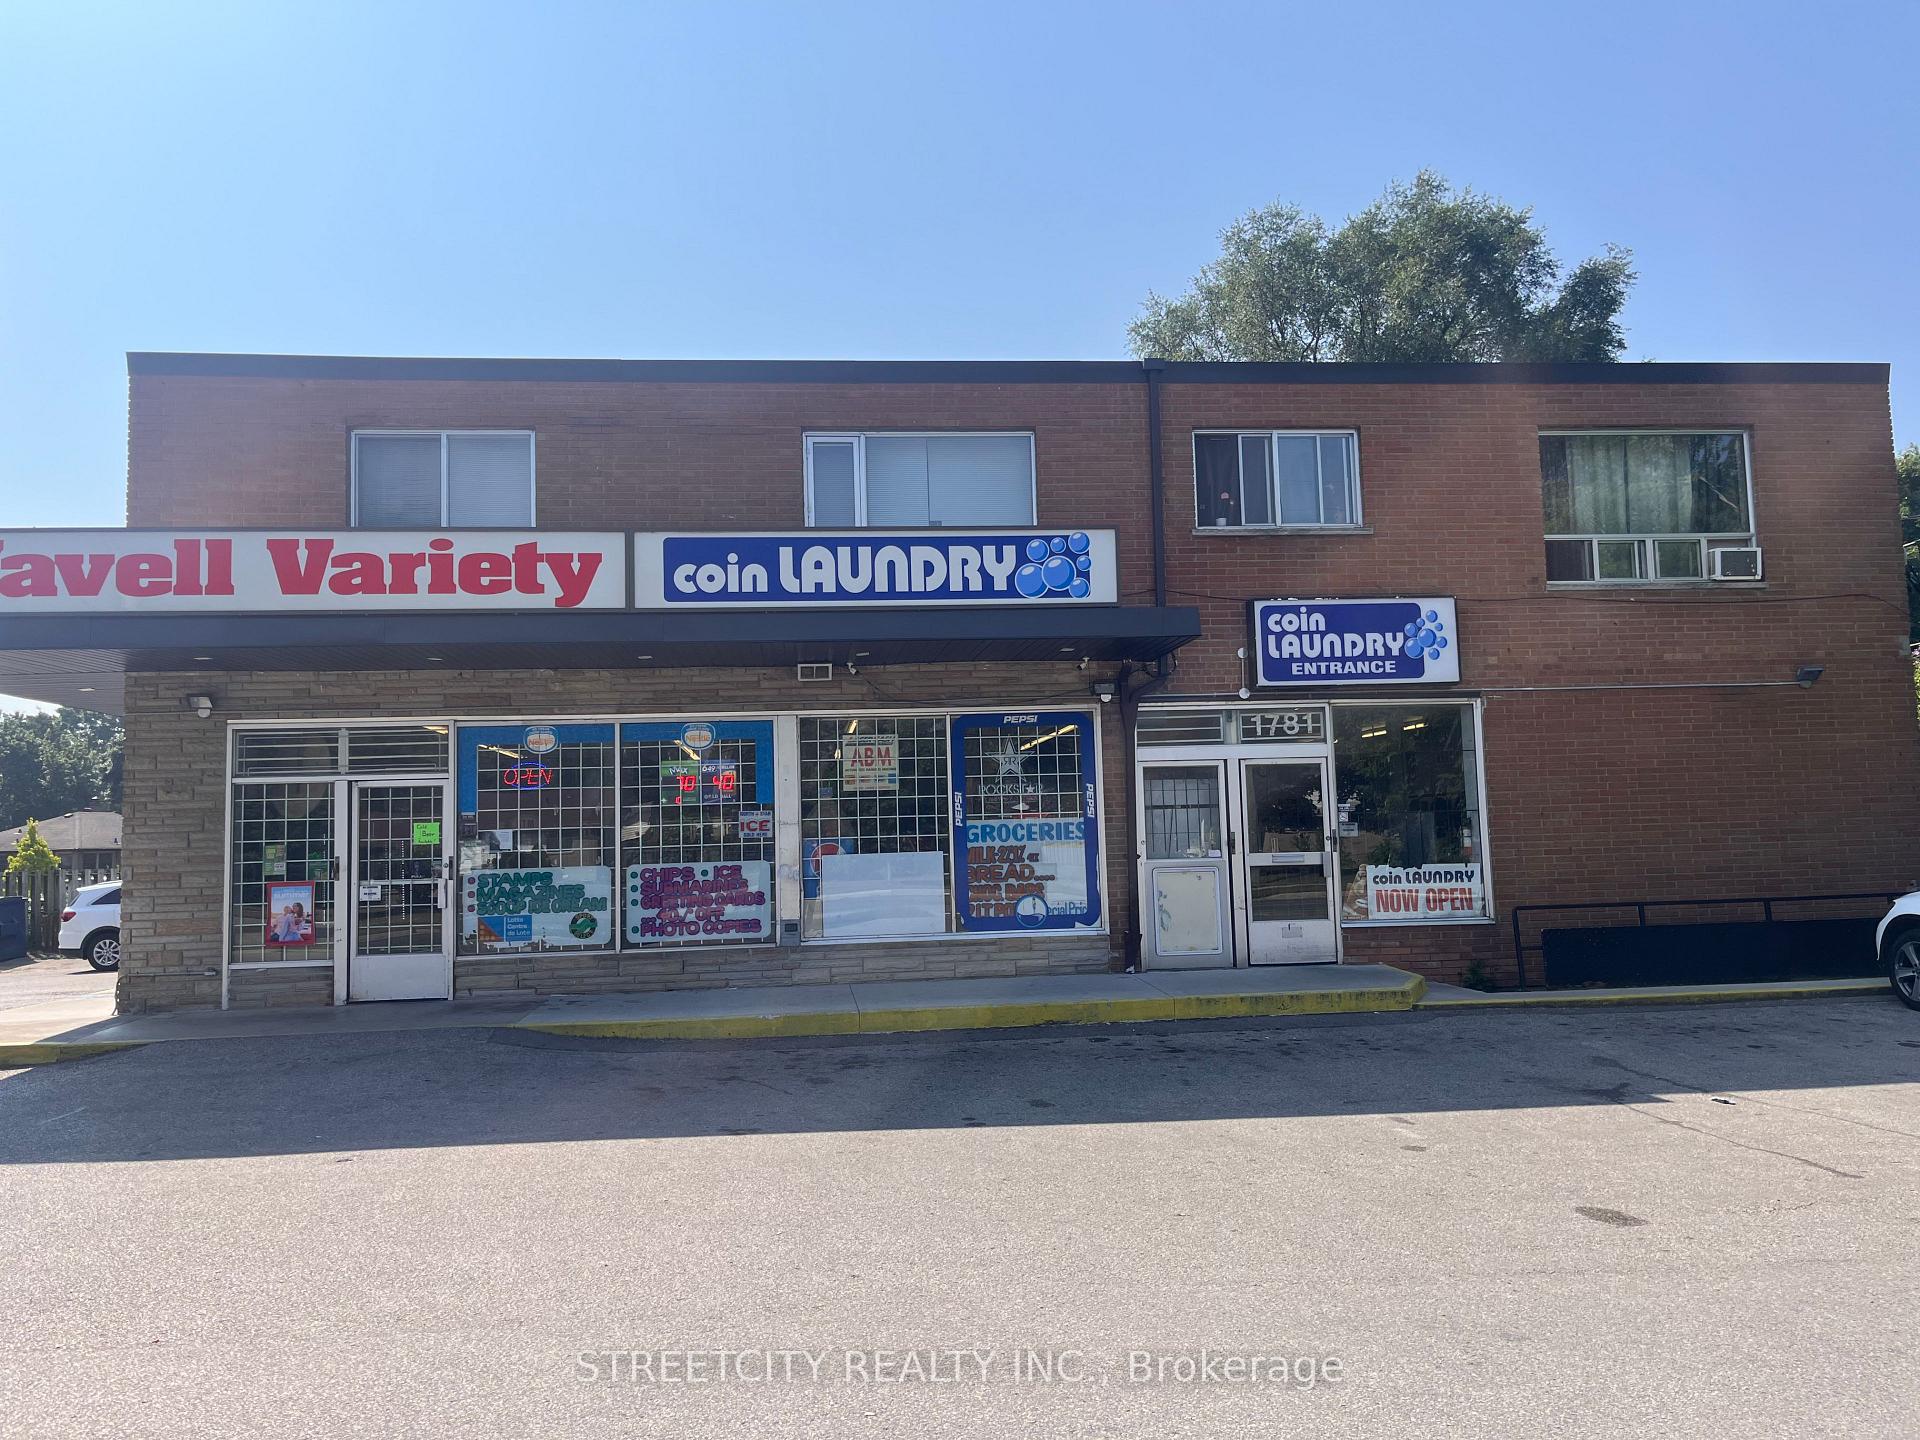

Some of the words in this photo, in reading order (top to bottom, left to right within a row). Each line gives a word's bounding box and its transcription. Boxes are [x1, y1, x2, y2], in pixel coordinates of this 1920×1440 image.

[0, 538, 235, 598] avell
[266, 538, 603, 608] Variety
[673, 552, 769, 594] coin
[779, 545, 1017, 594] LAUNDRY
[1267, 606, 1326, 633] coin
[1267, 632, 1405, 660] LAUNDRY
[1291, 660, 1397, 675] ENTRANCE
[1003, 714, 1038, 724] PEPSI
[1250, 712, 1314, 737] 1781
[850, 746, 892, 767] ABM
[503, 768, 553, 785] OPEN
[712, 774, 735, 790] 40
[954, 792, 963, 827] PEPSI
[1086, 783, 1095, 818] PEPSI
[740, 820, 770, 832] ICE
[967, 821, 1085, 843] GROCERIES
[477, 872, 553, 888] STAMPS
[640, 866, 696, 883] CHIPS
[713, 865, 743, 880] ICE
[1372, 871, 1402, 885] coin
[1405, 870, 1475, 884] LAUNDRY
[476, 884, 586, 902] MAGAZINES
[639, 878, 749, 896] SUBMARINES
[476, 900, 527, 915] SCOOP
[527, 899, 551, 913] ICE
[639, 893, 714, 910] GREETING
[714, 890, 766, 906] CARDS
[1375, 888, 1420, 913] NOW
[1425, 887, 1474, 913] OPEN
[695, 906, 726, 921] OFF
[640, 919, 700, 937] PHOTO
[702, 918, 763, 935] COPIES
